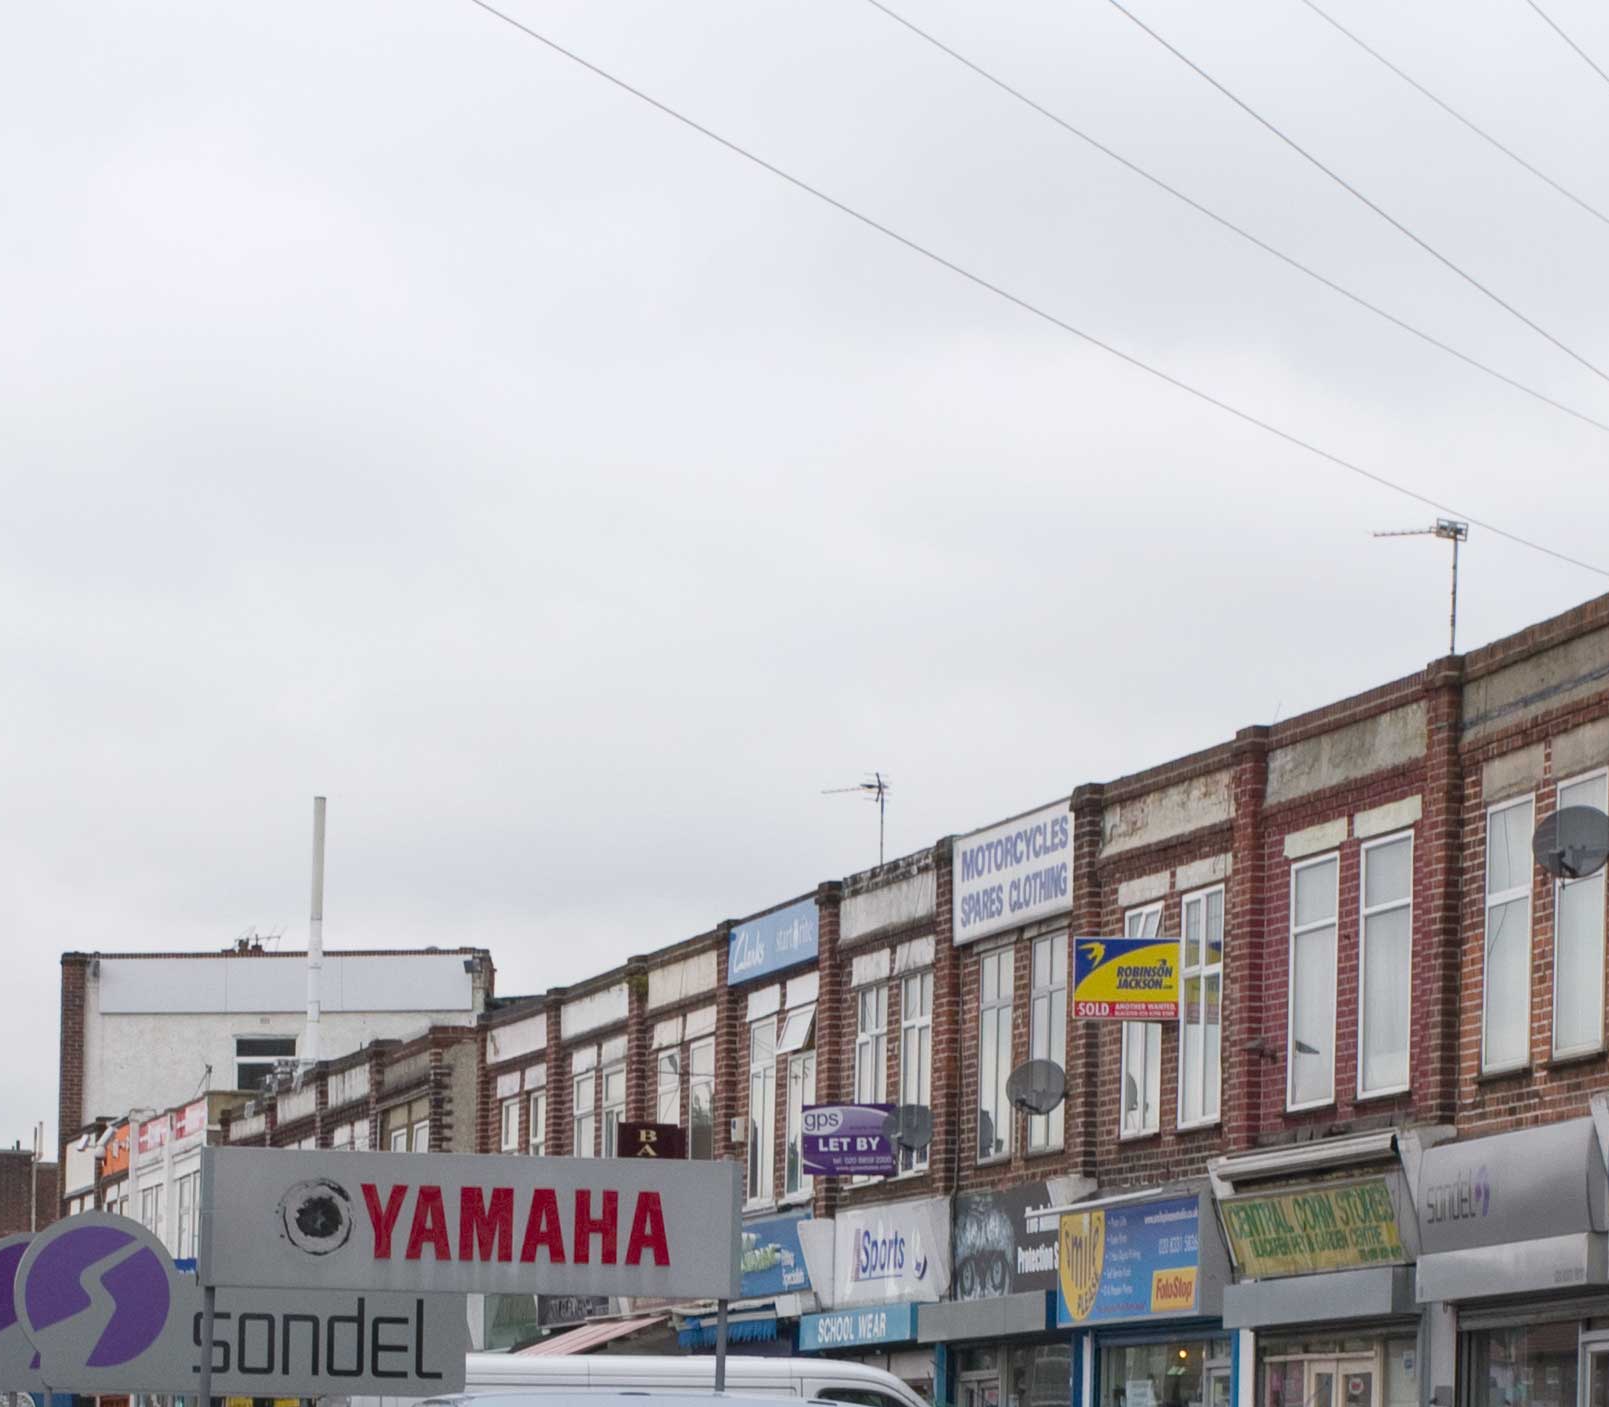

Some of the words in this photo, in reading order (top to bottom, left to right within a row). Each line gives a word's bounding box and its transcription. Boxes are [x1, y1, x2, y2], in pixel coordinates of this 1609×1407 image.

[961, 814, 1070, 883] MOTORCYCLES
[960, 884, 1004, 929] SPARES
[1008, 862, 1069, 914] CLOTHING
[1116, 965, 1173, 978] ROBINSON
[1077, 1002, 1110, 1016] SOLD
[804, 1112, 840, 1131] gps
[818, 1138, 851, 1151] LET
[856, 1136, 880, 1151] BY
[360, 1183, 671, 1267] YAMAHA
[1228, 1199, 1294, 1238] CENTRAL
[860, 1229, 905, 1275] Sports
[1017, 1243, 1054, 1275] Protection
[817, 1314, 855, 1343] SCHOOL
[858, 1312, 886, 1338] WEAR
